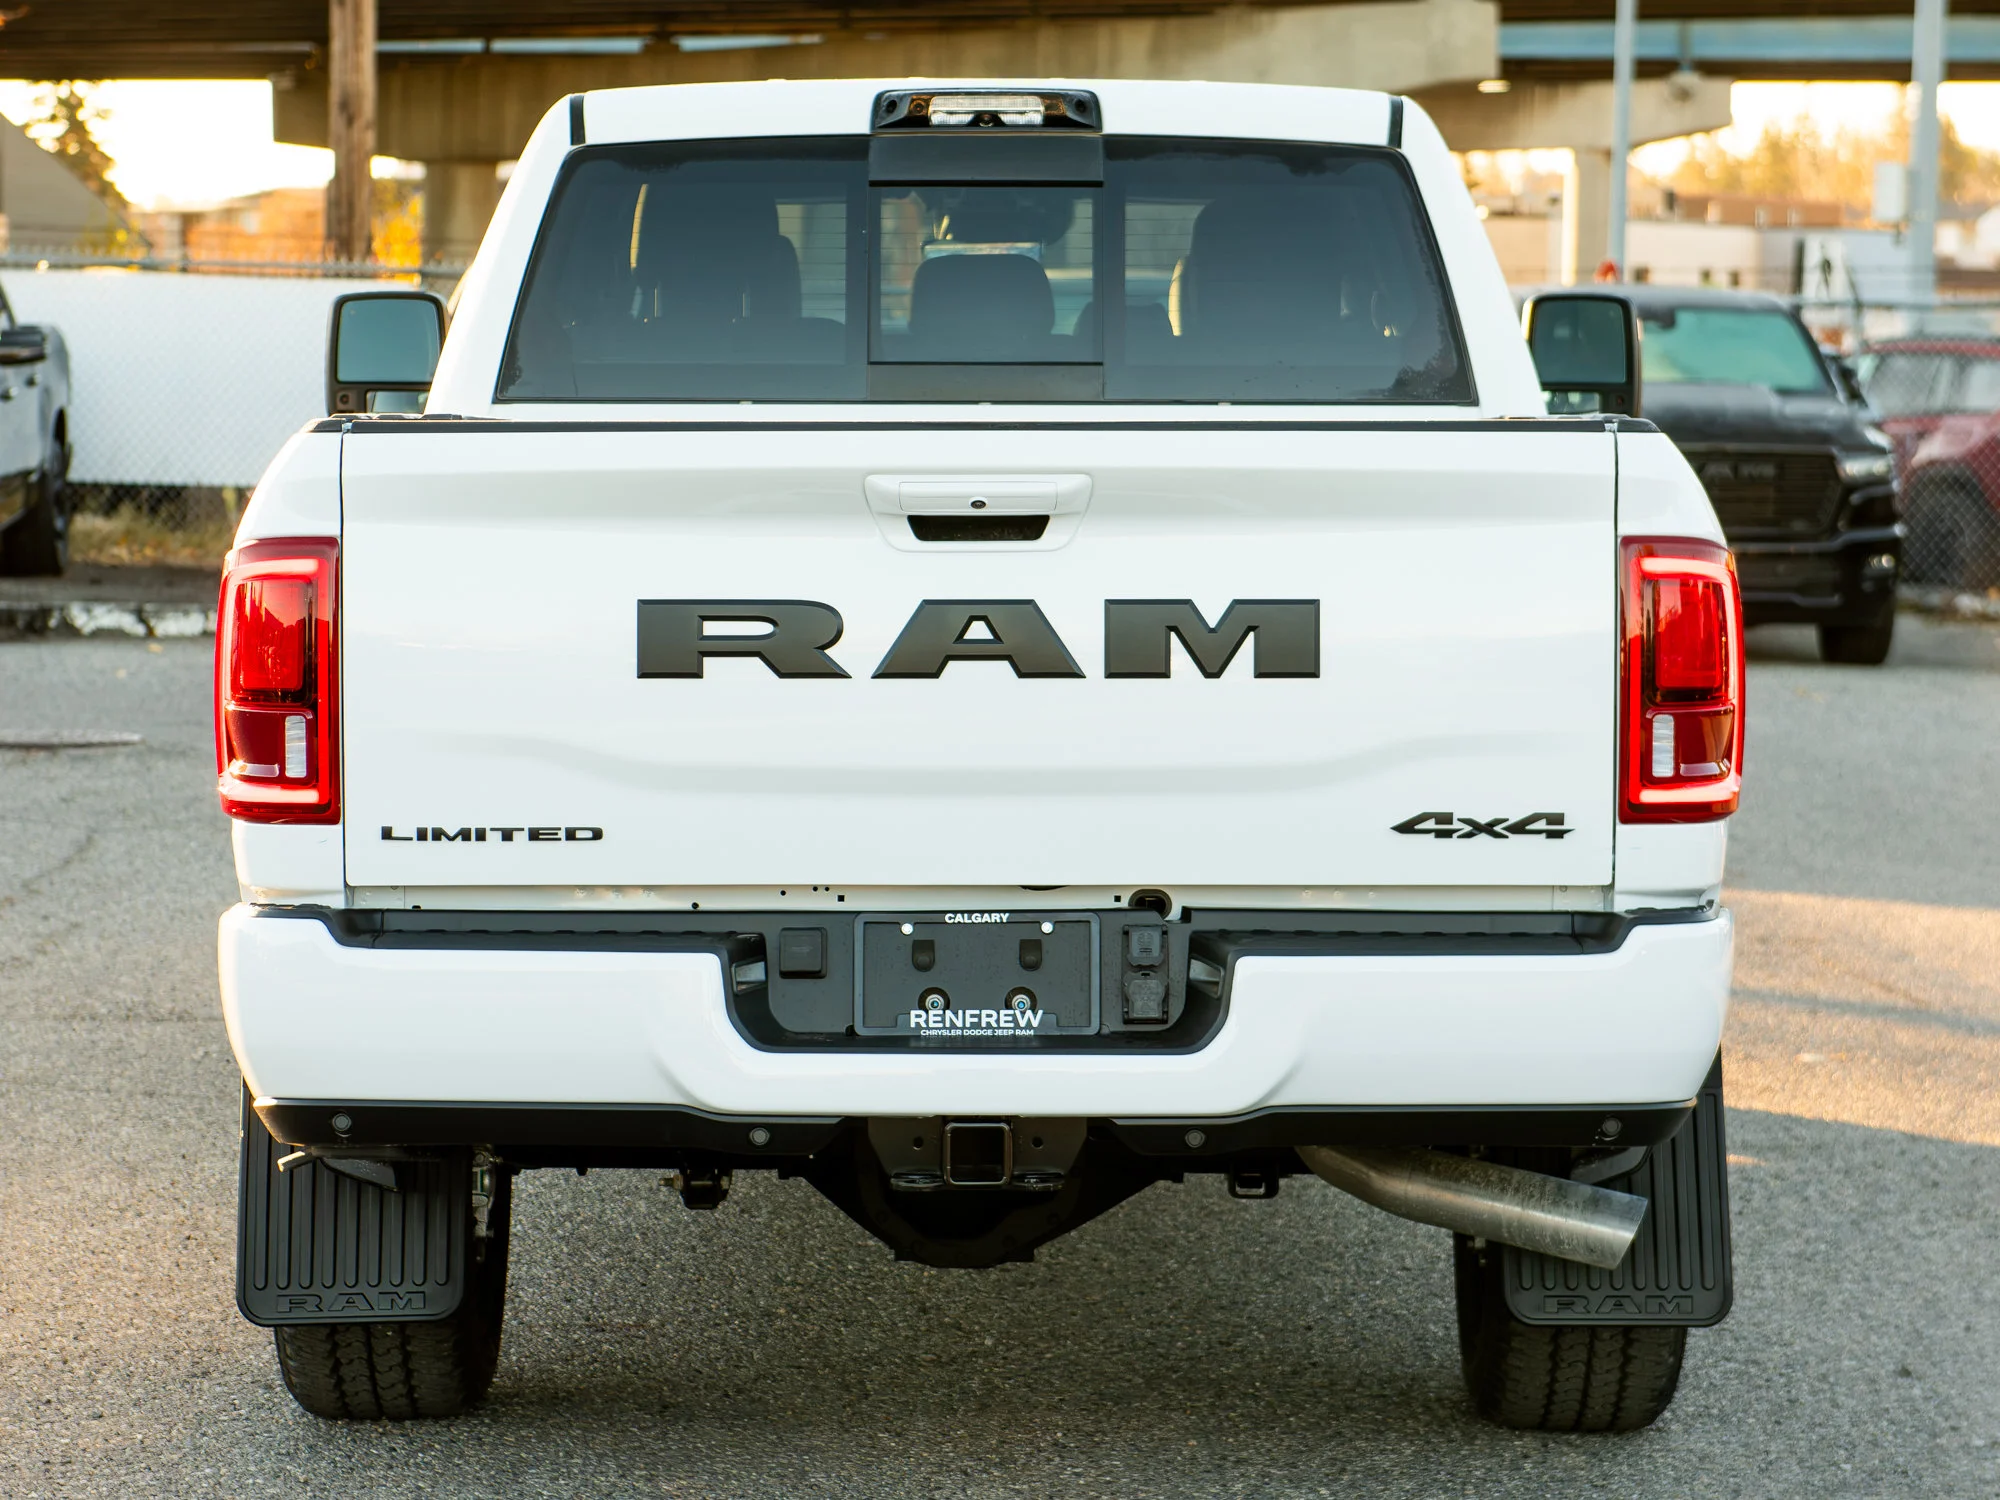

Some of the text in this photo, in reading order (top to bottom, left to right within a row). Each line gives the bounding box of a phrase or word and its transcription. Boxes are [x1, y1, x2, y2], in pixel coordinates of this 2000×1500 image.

[637, 599, 1320, 679] RAM
[381, 826, 603, 841] LIMITED
[1390, 812, 1574, 839] 4x4
[944, 912, 1010, 924] CALGARY
[909, 1009, 1044, 1028] RENFREW
[276, 1291, 426, 1313] RAM
[1543, 1294, 1694, 1315] RAM
